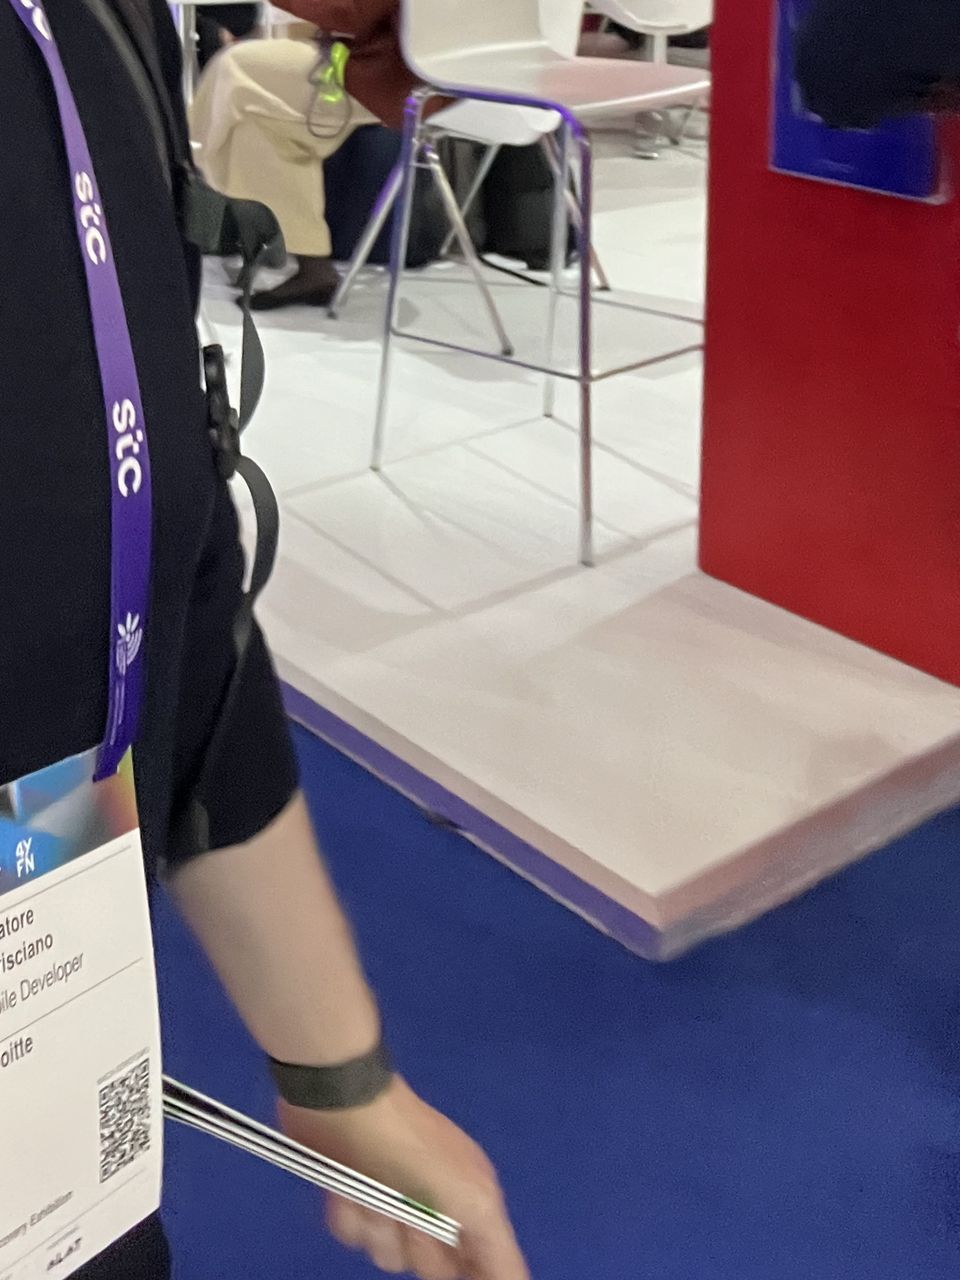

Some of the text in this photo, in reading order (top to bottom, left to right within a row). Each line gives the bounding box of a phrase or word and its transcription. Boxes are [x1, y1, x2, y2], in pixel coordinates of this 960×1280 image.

[75, 171, 107, 265] stc
[112, 398, 143, 497] stc
[20, 951, 85, 999] Developer
